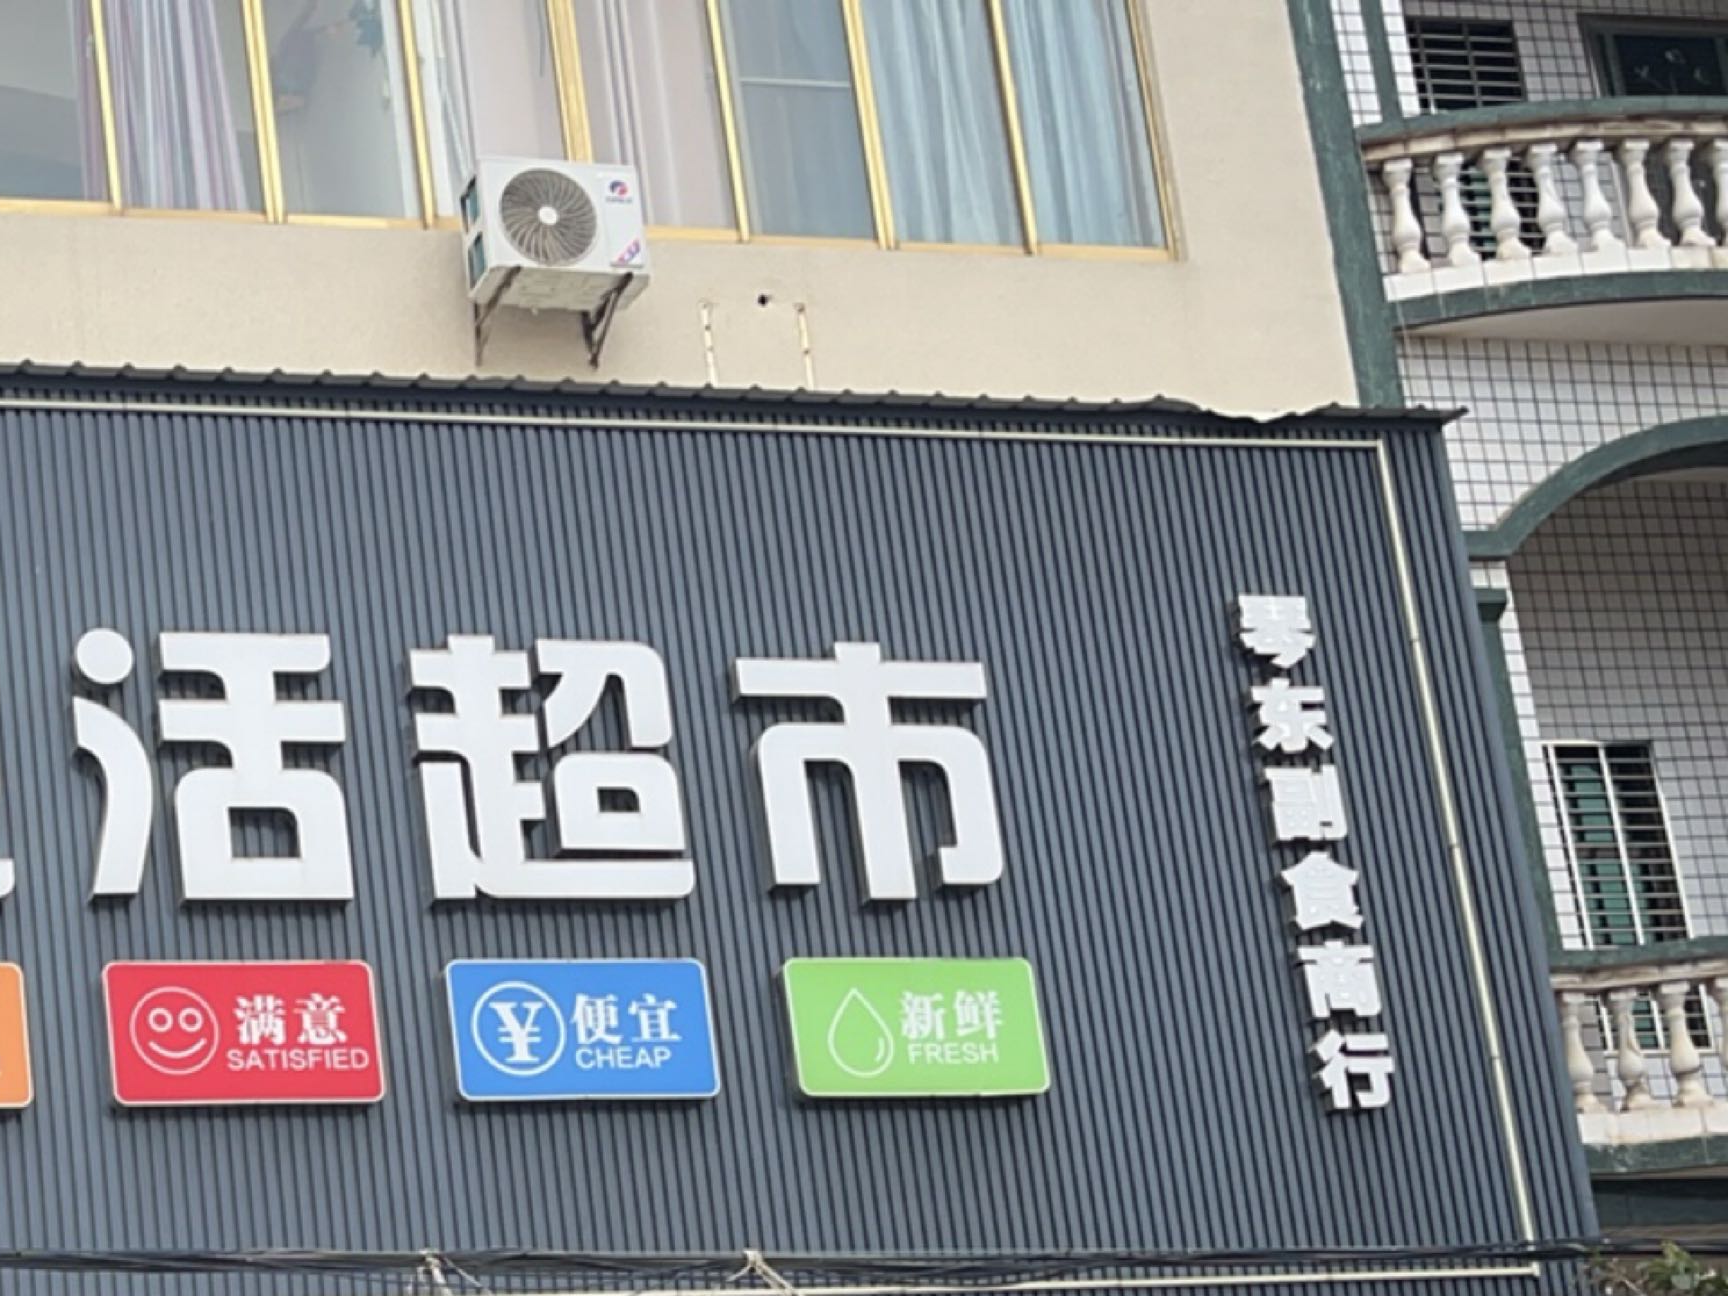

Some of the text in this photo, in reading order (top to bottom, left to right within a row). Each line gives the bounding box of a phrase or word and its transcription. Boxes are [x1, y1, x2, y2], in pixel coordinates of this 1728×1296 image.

[233, 993, 349, 1046] 满意
[570, 992, 683, 1045] 便宜
[900, 990, 1004, 1042] 新鲜
[226, 1046, 370, 1072] SATISFIED
[575, 1045, 672, 1070] CHEAP
[907, 1041, 1000, 1065] FRESH
